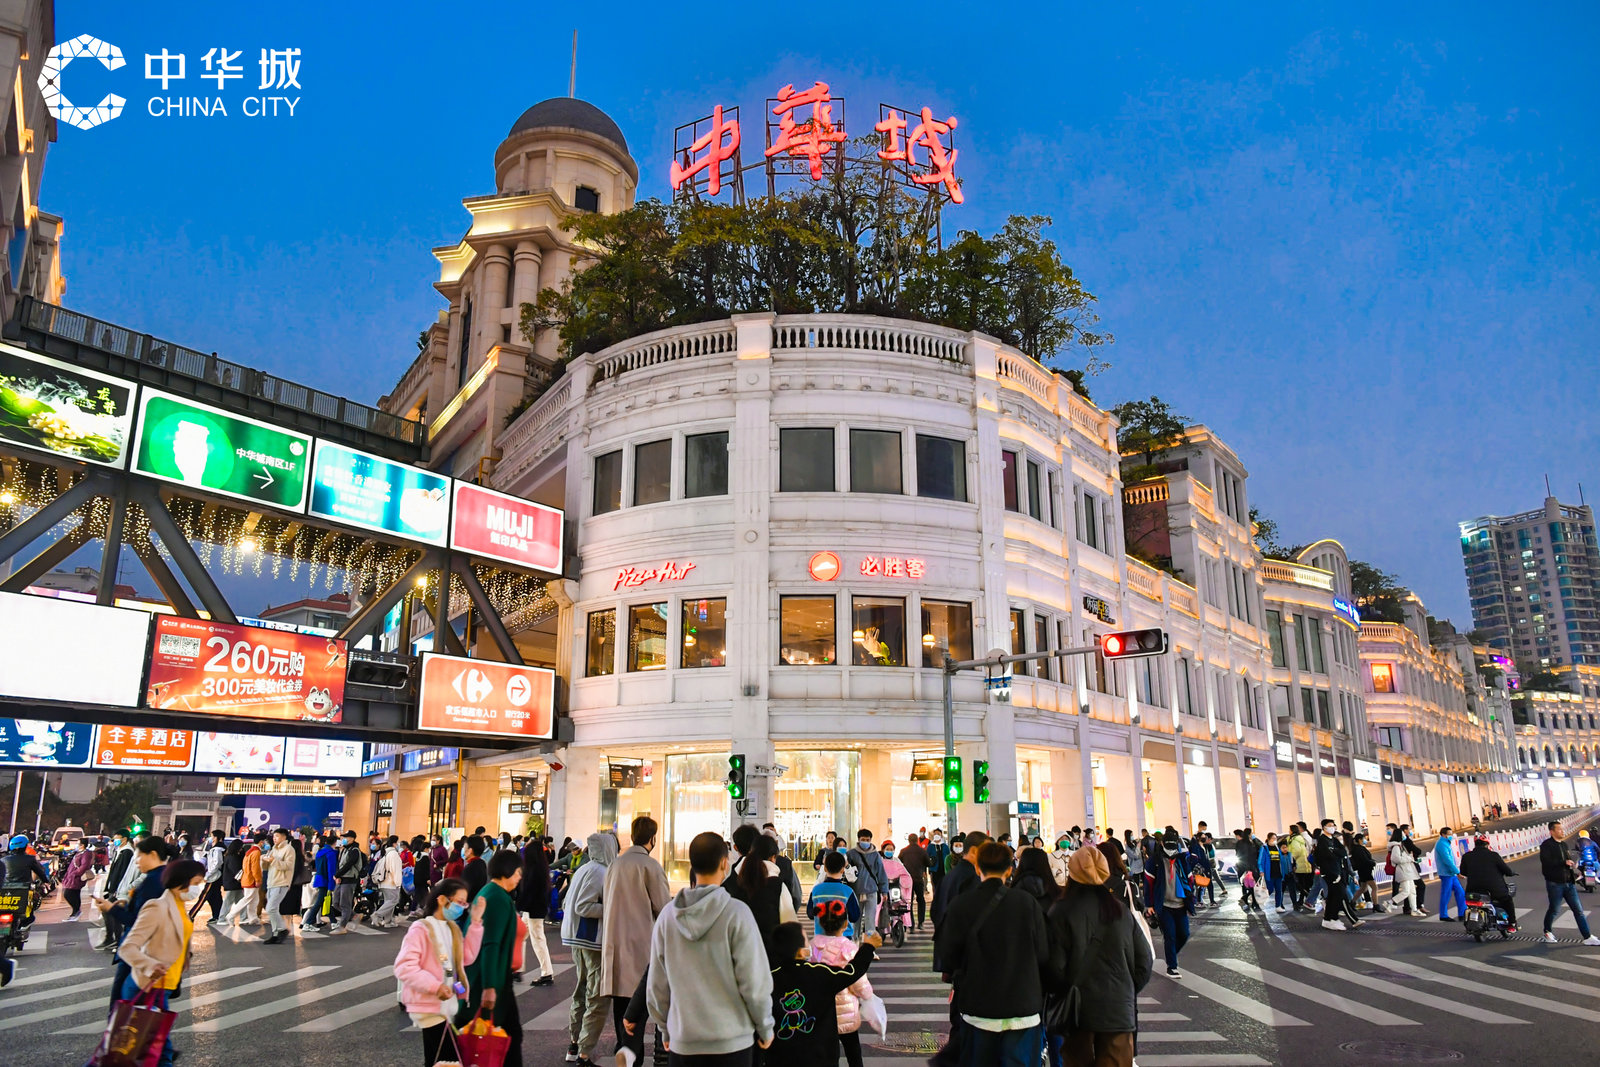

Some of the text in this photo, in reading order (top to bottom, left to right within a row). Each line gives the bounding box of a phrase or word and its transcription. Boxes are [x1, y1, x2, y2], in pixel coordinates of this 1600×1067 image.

[486, 504, 534, 540] MUJI
[613, 560, 697, 591] Pizza Hut
[859, 555, 926, 579] 必胜客
[203, 635, 306, 678] 260元购
[200, 677, 303, 698] 300元美妆代金券
[107, 726, 187, 748] 全季酒店
